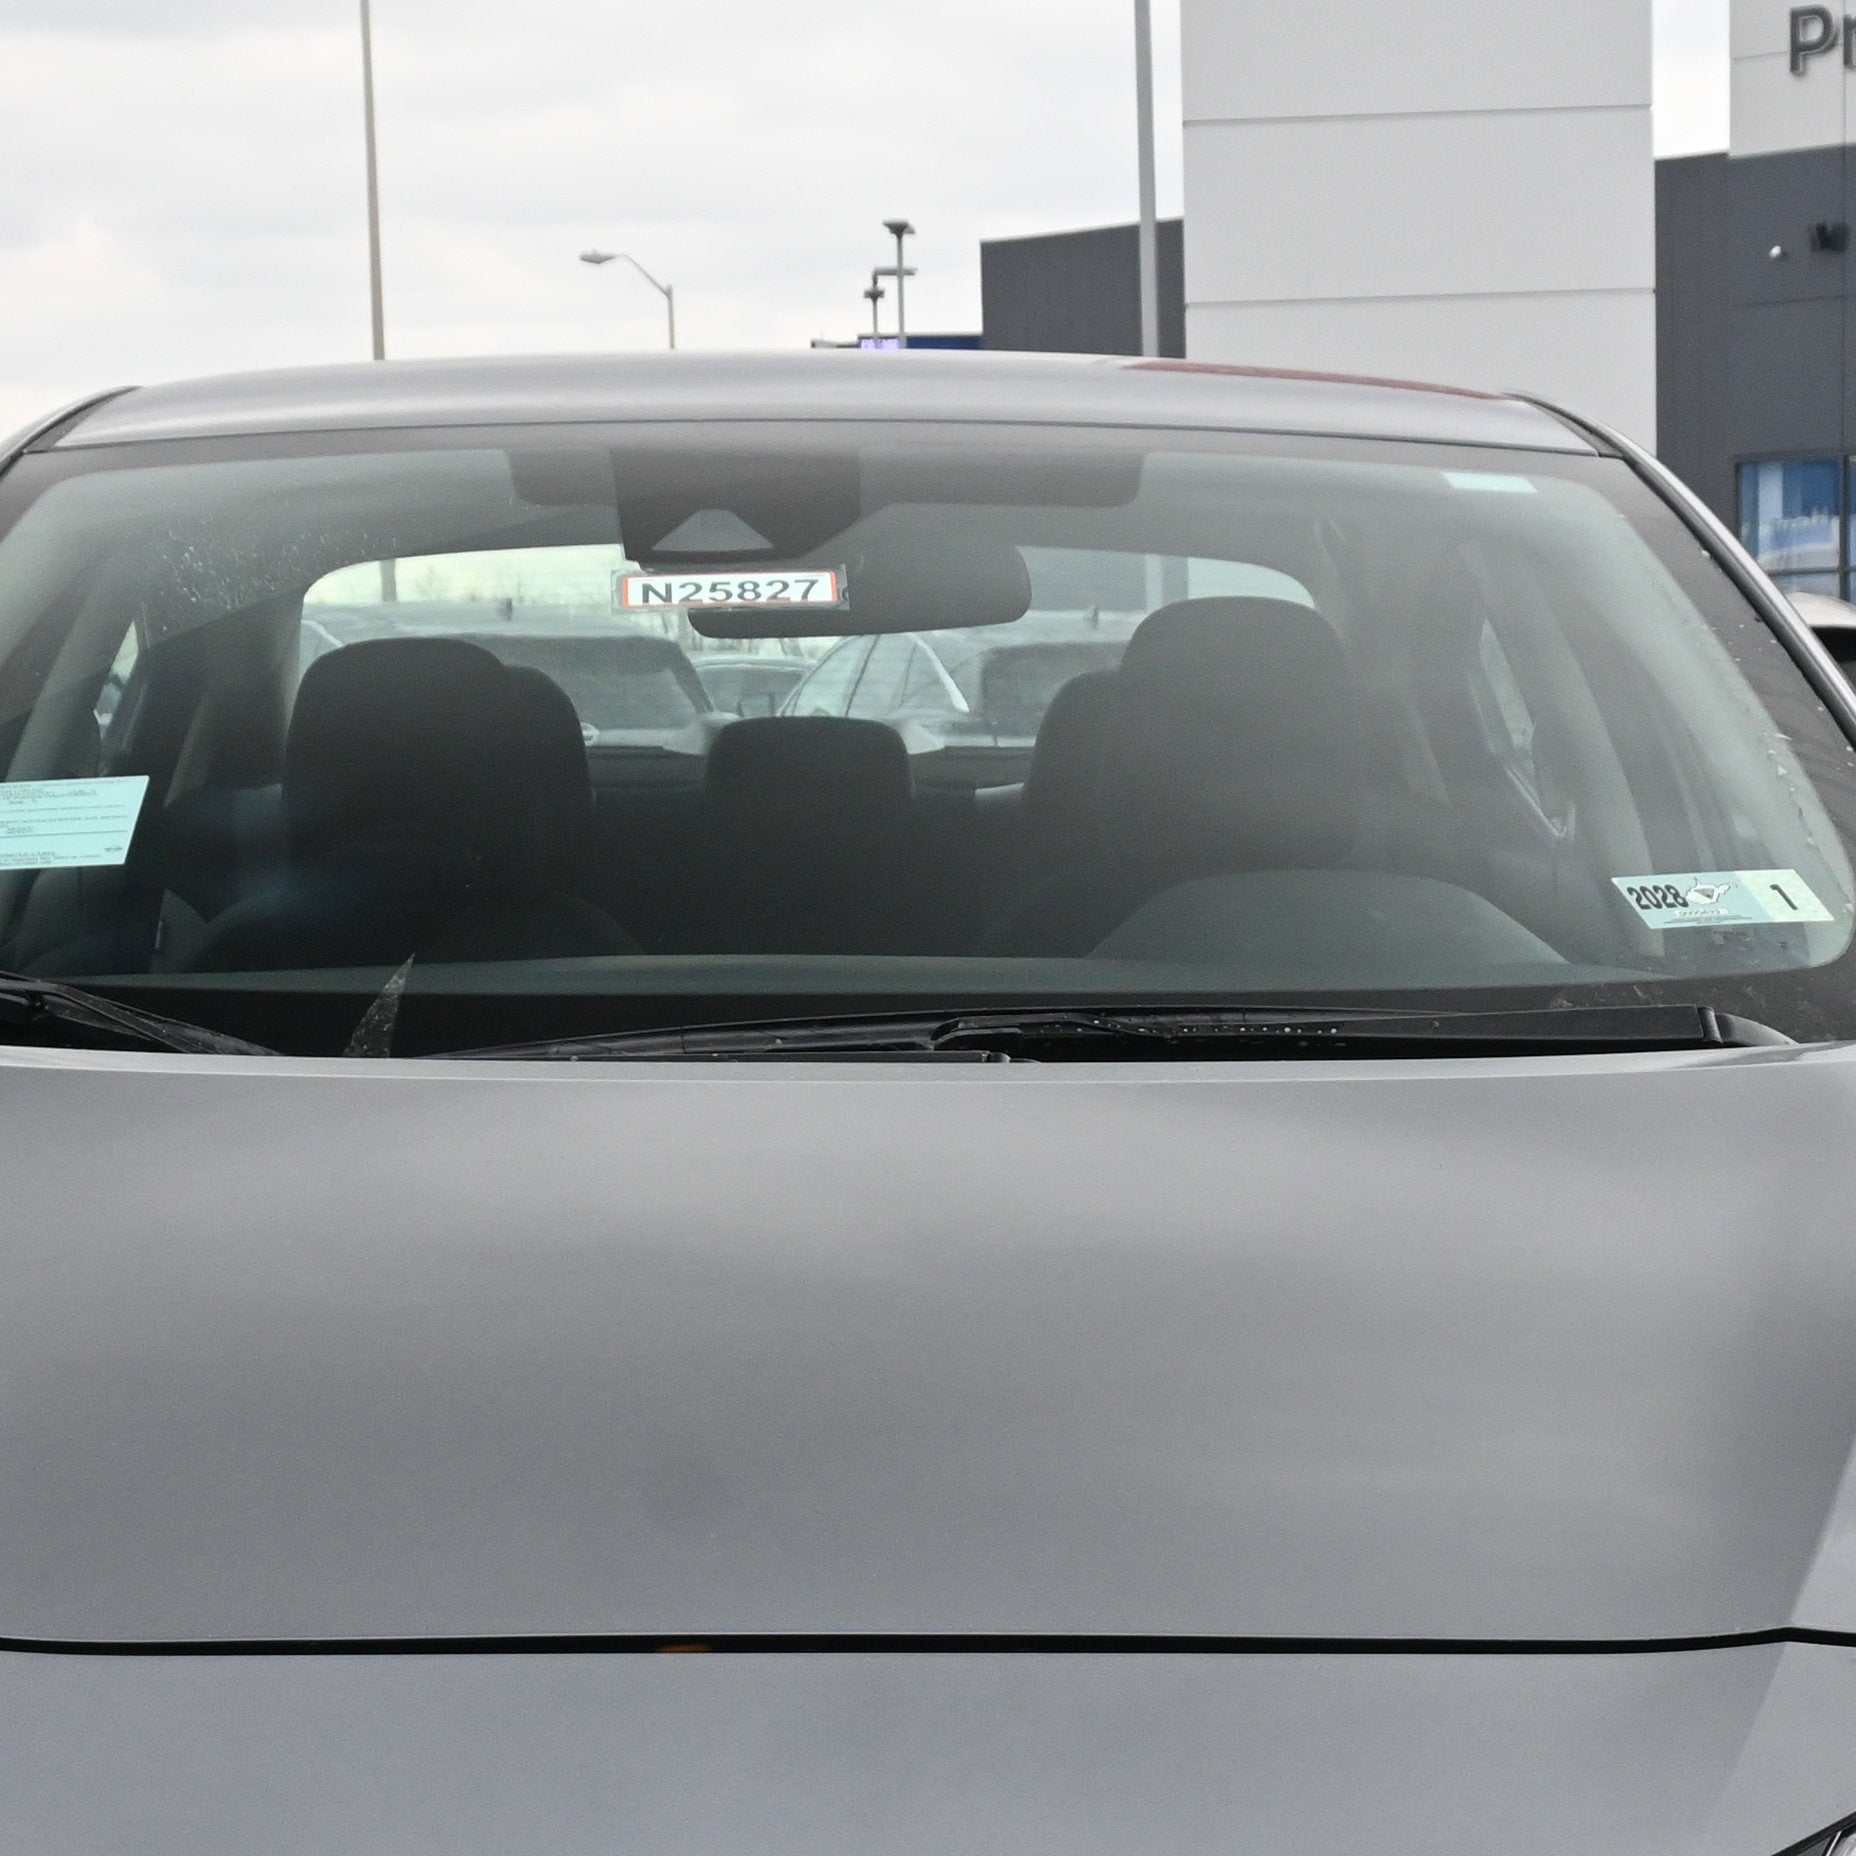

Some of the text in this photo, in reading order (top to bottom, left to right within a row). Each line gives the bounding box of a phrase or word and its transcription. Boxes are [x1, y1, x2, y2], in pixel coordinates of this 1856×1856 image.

[641, 578, 820, 604] N25827
[1627, 883, 1799, 911] 2028 1
